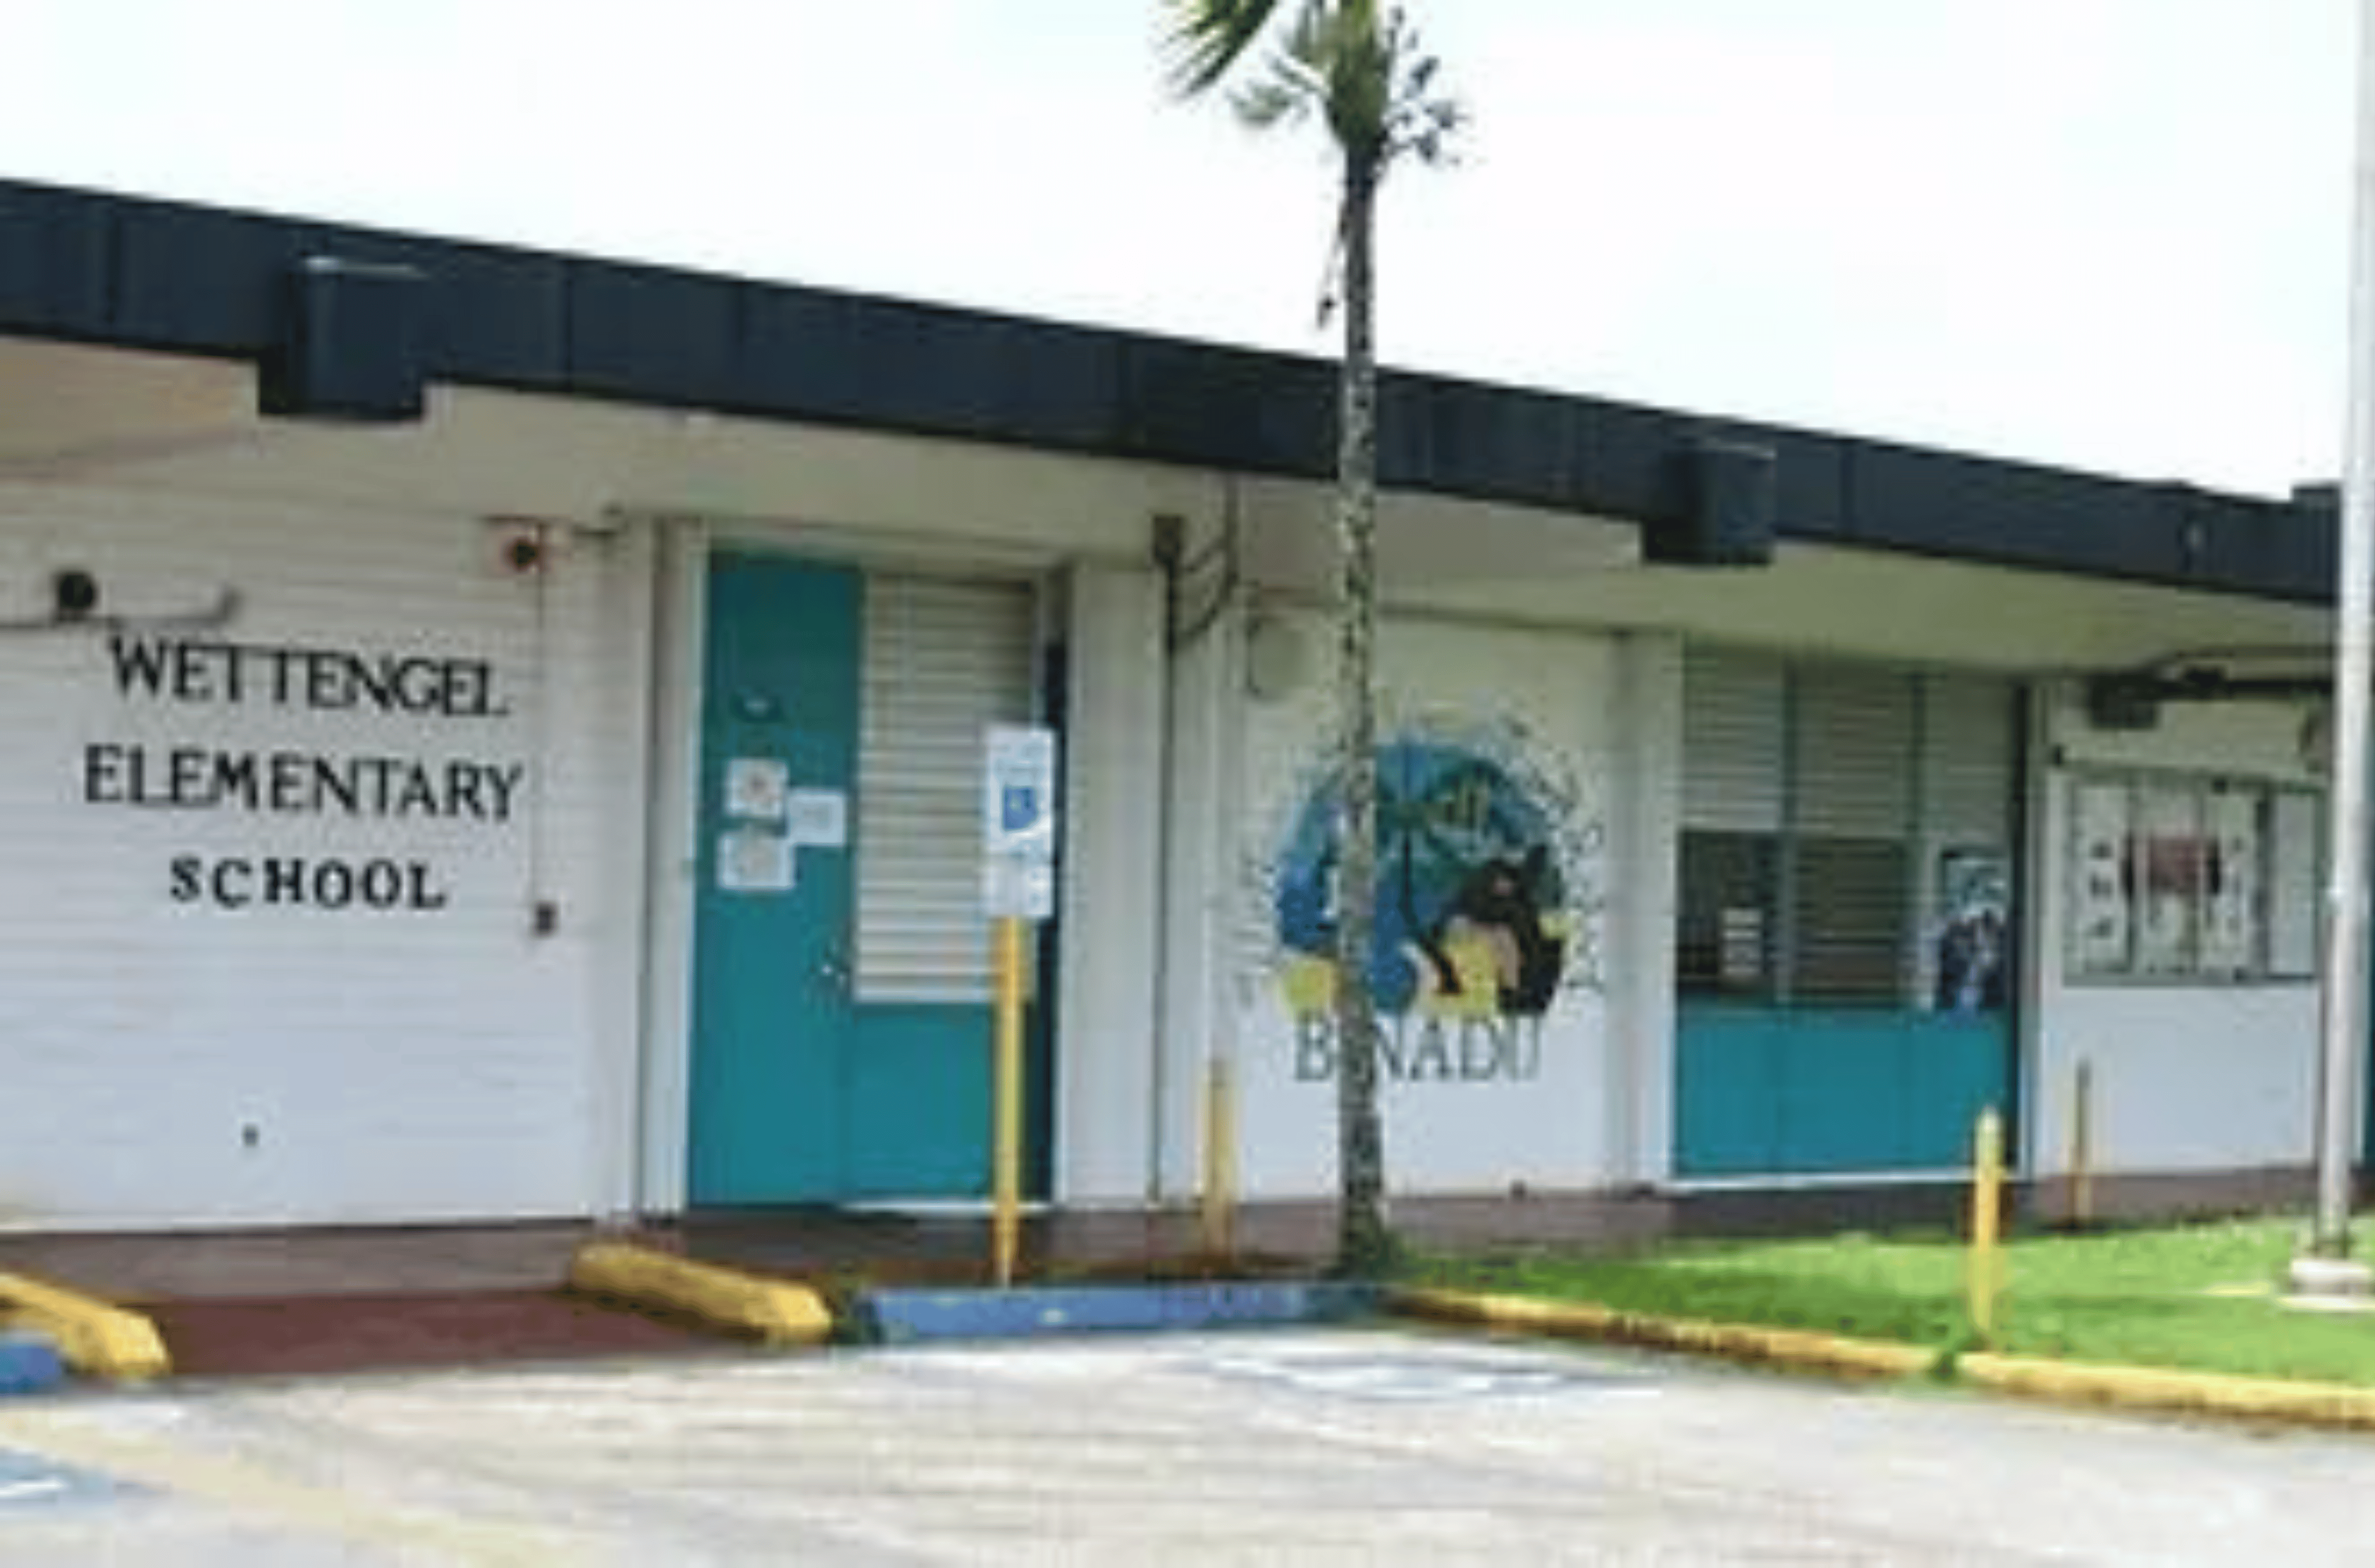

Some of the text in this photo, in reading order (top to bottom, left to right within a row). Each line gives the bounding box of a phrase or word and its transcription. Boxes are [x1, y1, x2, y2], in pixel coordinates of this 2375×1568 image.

[108, 634, 510, 716] WETTENGEL
[84, 742, 523, 822] ELEMENTARY
[170, 855, 447, 909] SCHOOL
[1295, 1012, 1544, 1080] BNADU
